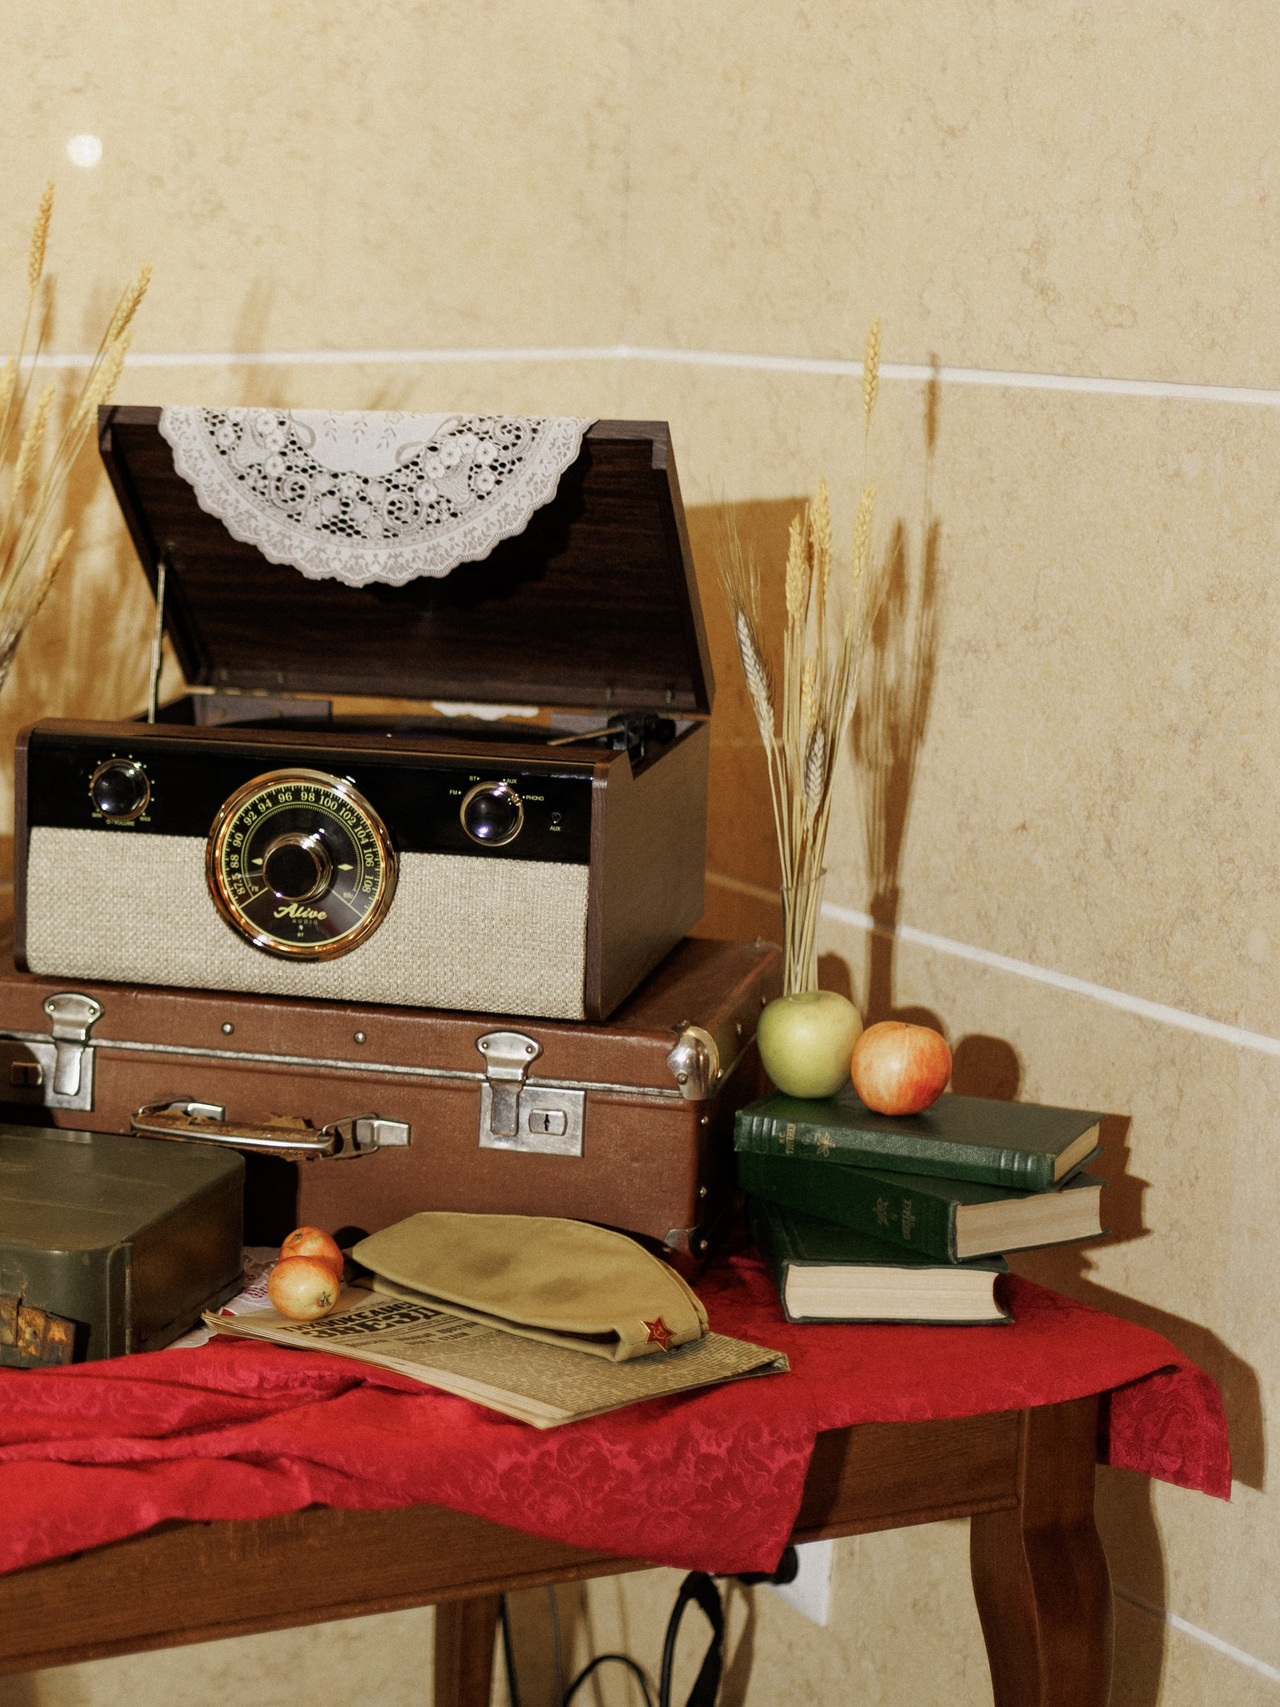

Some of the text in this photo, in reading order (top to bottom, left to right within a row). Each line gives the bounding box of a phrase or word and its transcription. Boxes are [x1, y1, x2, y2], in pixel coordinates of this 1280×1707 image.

[278, 791, 293, 803] 96
[300, 792, 315, 802] 98
[319, 796, 338, 811] 100
[257, 799, 273, 812] 94
[243, 811, 257, 826] 92
[339, 808, 357, 826] 102
[233, 832, 244, 848] 90
[354, 826, 369, 845] 104
[230, 854, 240, 868] 88
[363, 848, 374, 867] 106
[362, 875, 374, 893] 108
[273, 902, 328, 920] Alive
[301, 1306, 447, 1339] ЗВЕЗД
